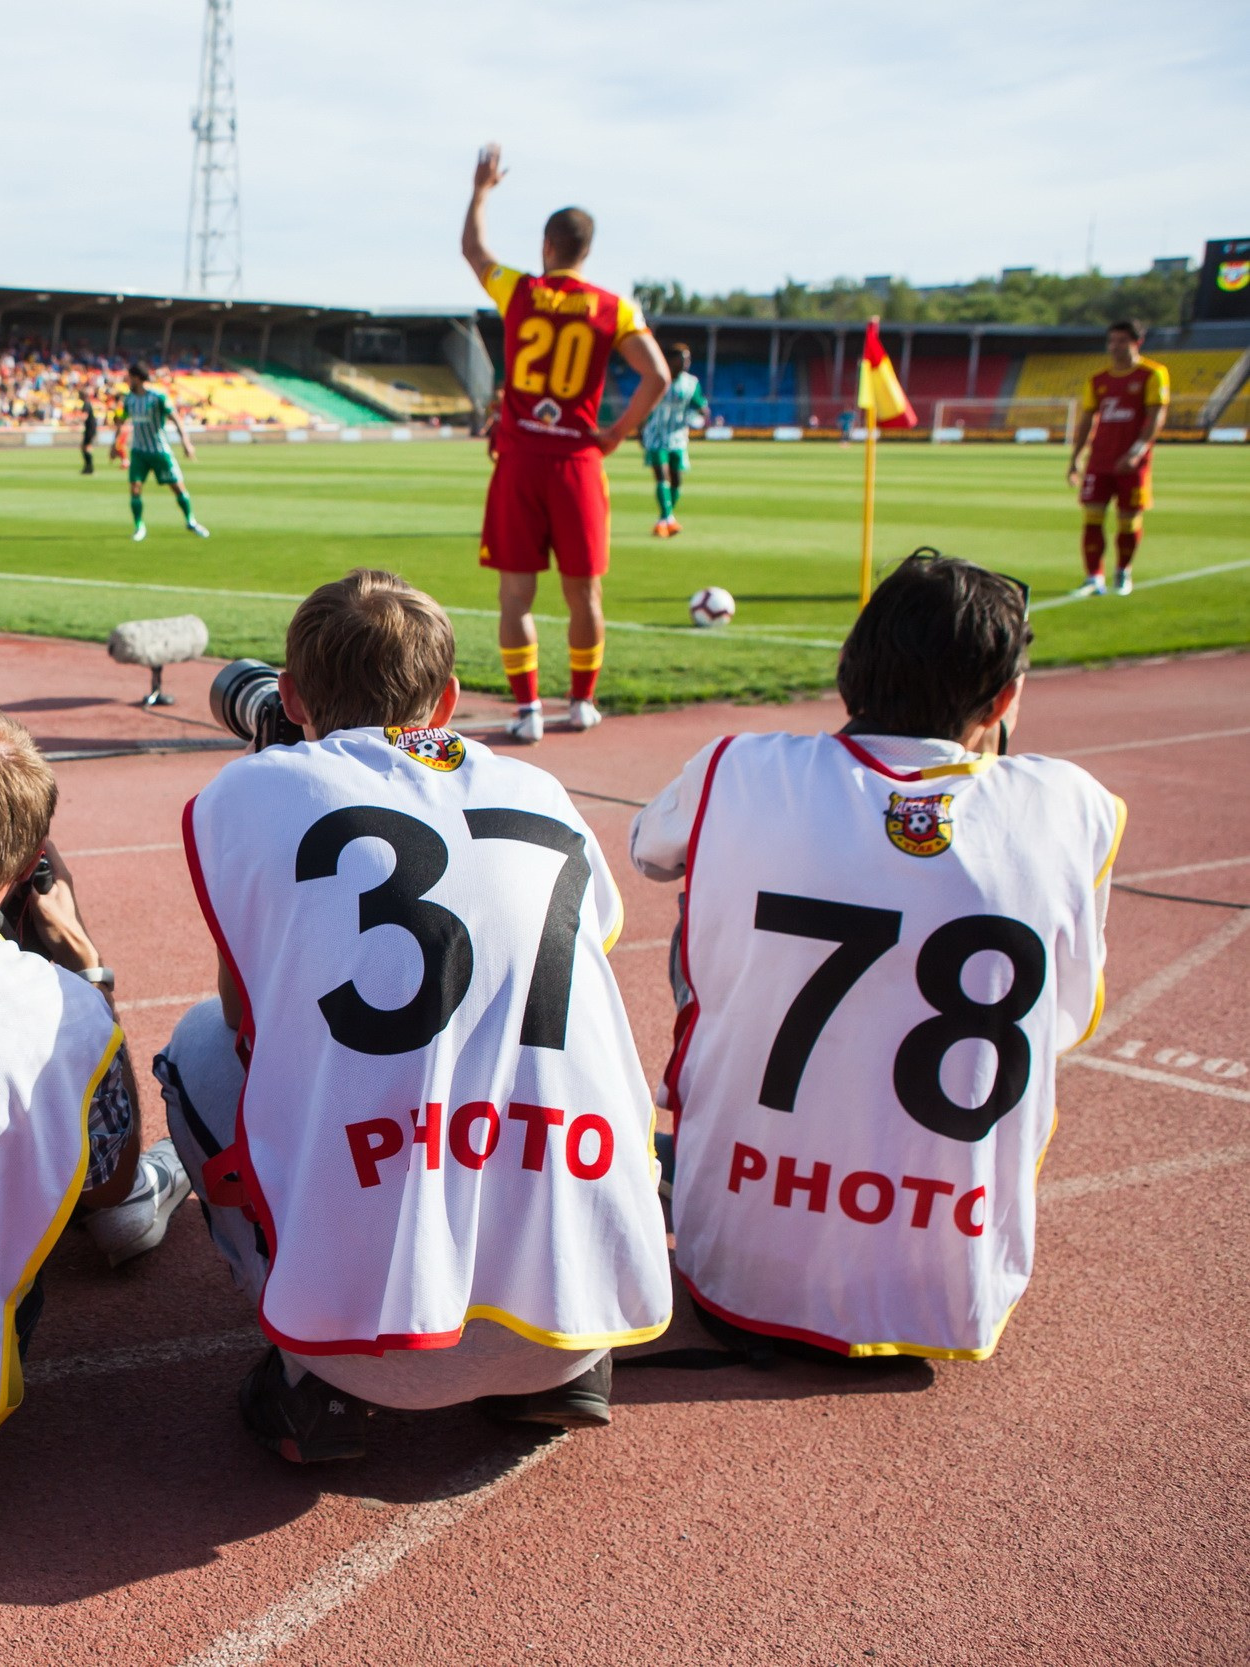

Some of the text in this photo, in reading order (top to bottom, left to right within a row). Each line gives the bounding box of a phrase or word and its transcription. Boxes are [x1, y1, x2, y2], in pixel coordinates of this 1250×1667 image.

[512, 316, 594, 399] 20
[295, 805, 590, 1056] 37
[754, 891, 1047, 1142] 78
[344, 1100, 615, 1189] PHOTO
